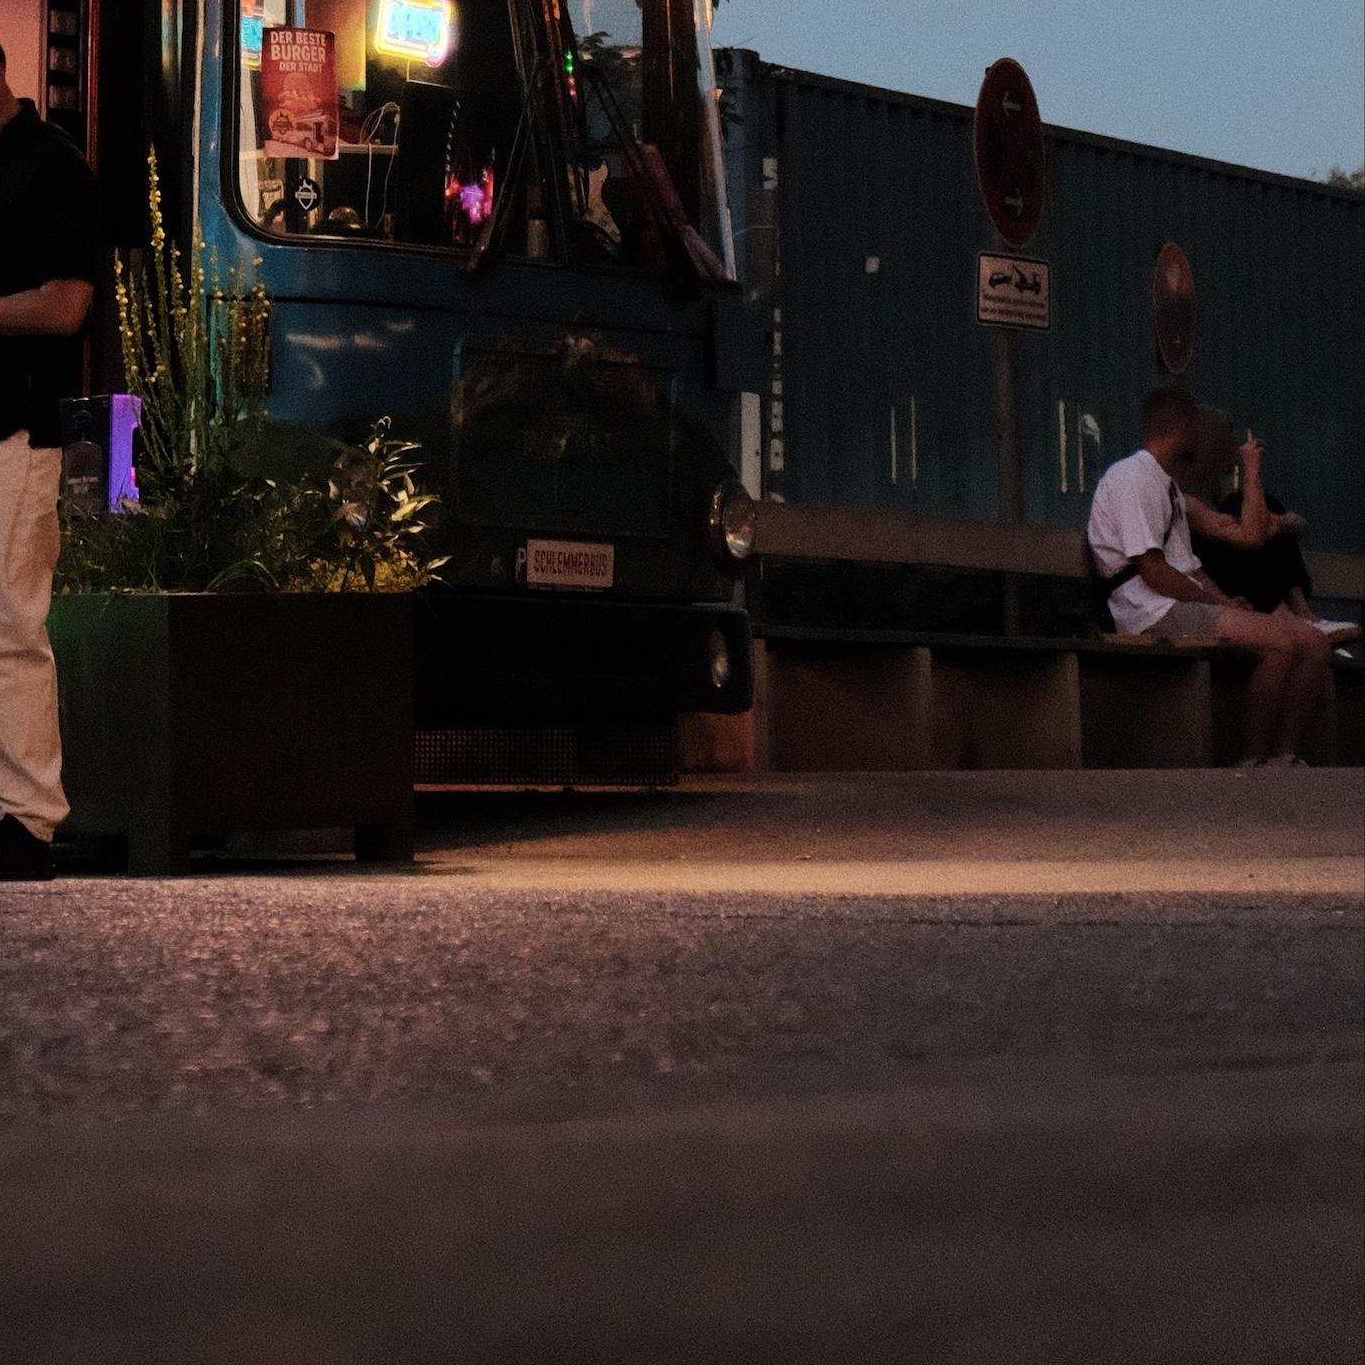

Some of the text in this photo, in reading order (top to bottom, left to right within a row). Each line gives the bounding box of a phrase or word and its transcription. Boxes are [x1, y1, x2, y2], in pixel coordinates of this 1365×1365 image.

[270, 31, 326, 47] DER BESTE
[271, 44, 326, 63] BURGER
[279, 61, 323, 73] DER STADT
